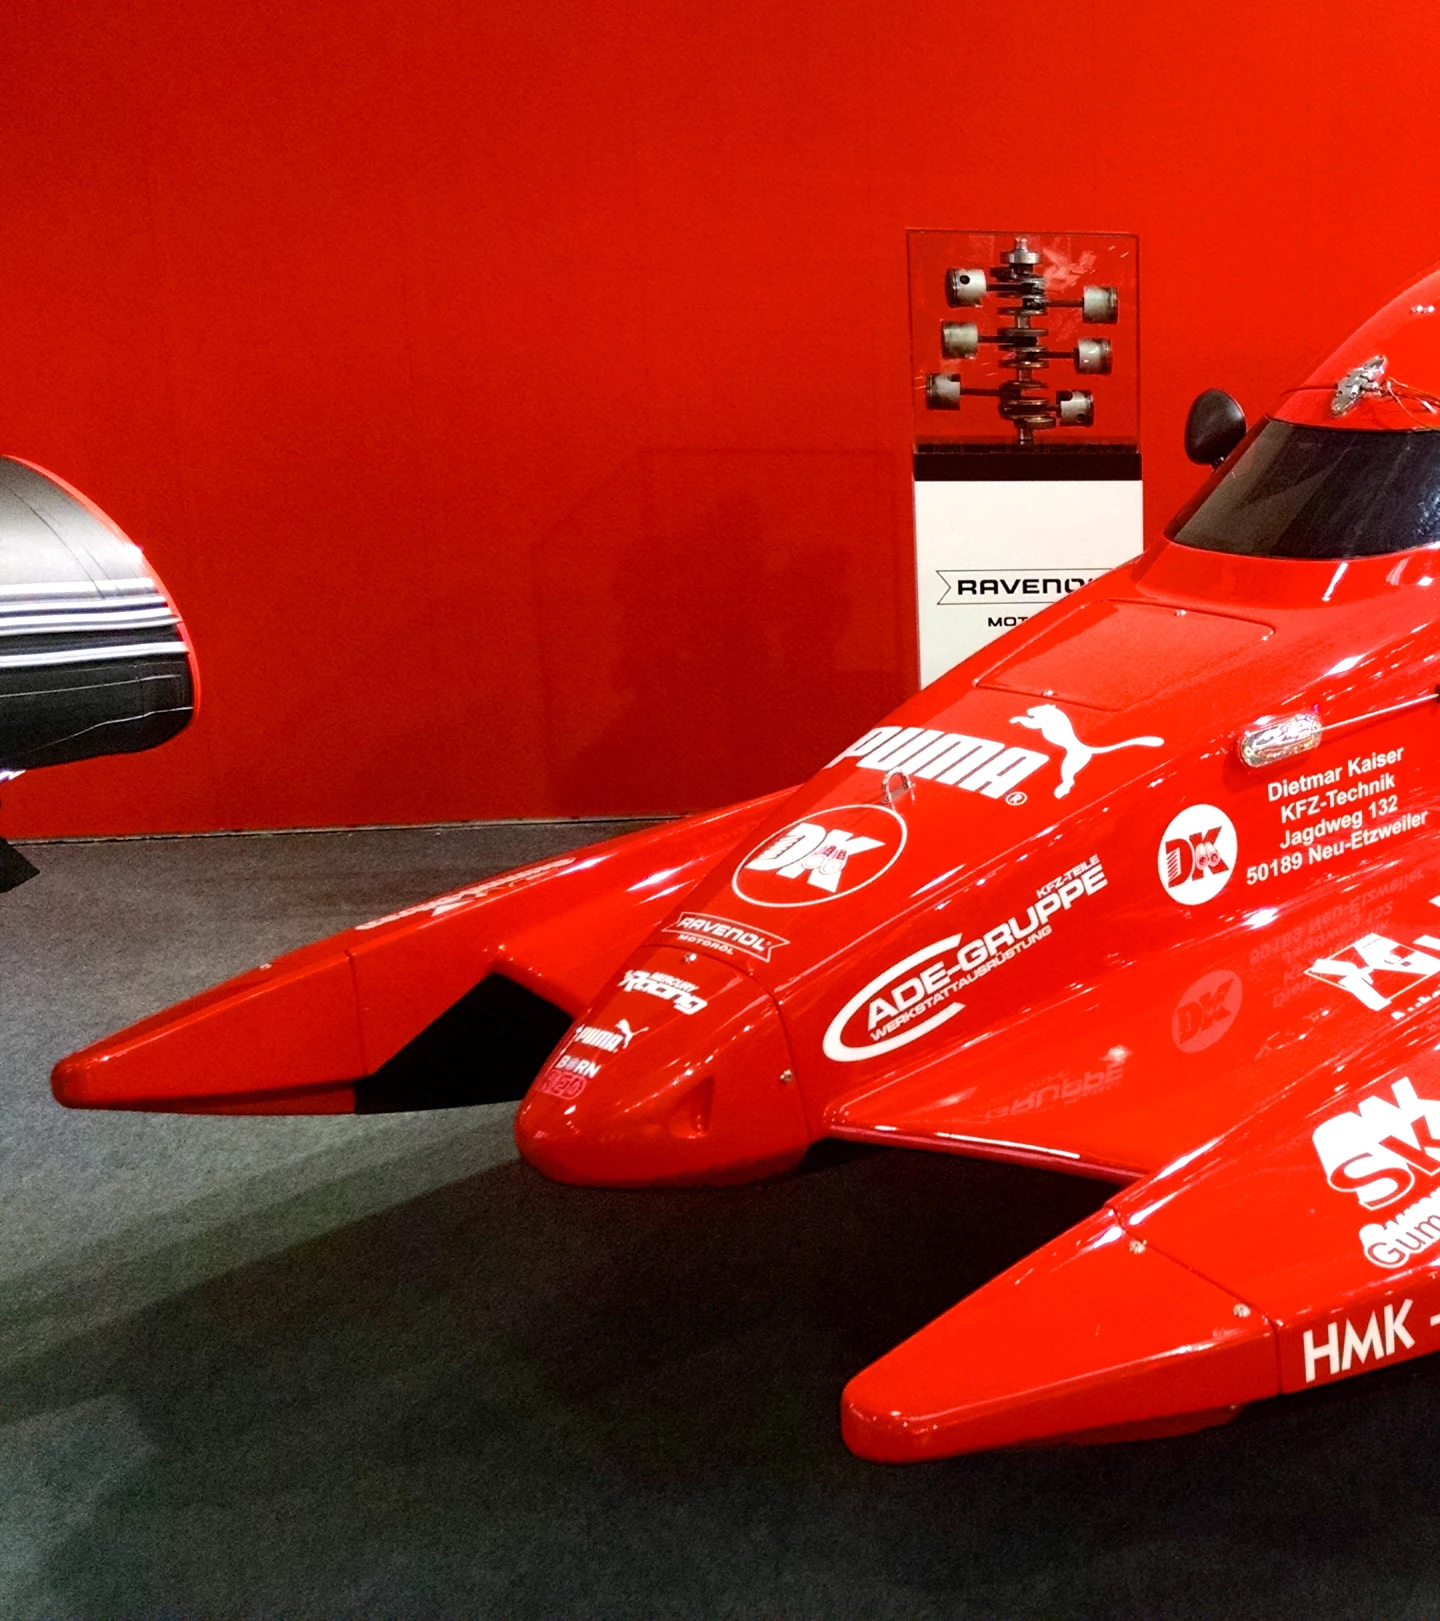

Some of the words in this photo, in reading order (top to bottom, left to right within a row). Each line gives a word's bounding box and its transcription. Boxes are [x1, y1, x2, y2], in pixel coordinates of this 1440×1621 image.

[957, 577, 1094, 596] RAVENO
[823, 725, 1051, 800] PUMA
[1267, 764, 1343, 803] Dietmar
[1347, 747, 1405, 772] Kaiser
[1279, 808, 1363, 850] Jagdweg
[1367, 794, 1399, 820] 132
[1280, 771, 1396, 824] KFZ-Technik
[1165, 825, 1230, 889] DK
[1246, 851, 1304, 886] 50189
[1308, 810, 1429, 867] Neu-Etzweiler
[1035, 854, 1101, 899] KFZ-TEILE
[675, 916, 772, 952] RAVENOL
[677, 934, 735, 956] MOTORÖL
[867, 864, 1109, 1032] ADE-GRUPPE
[617, 969, 709, 1015] Racing
[651, 971, 700, 993] MERCURY
[870, 924, 1053, 1042] WERKSTATTAUSRÜSTUNG
[573, 1026, 625, 1053] PUMA
[1302, 1298, 1416, 1384] HMK
